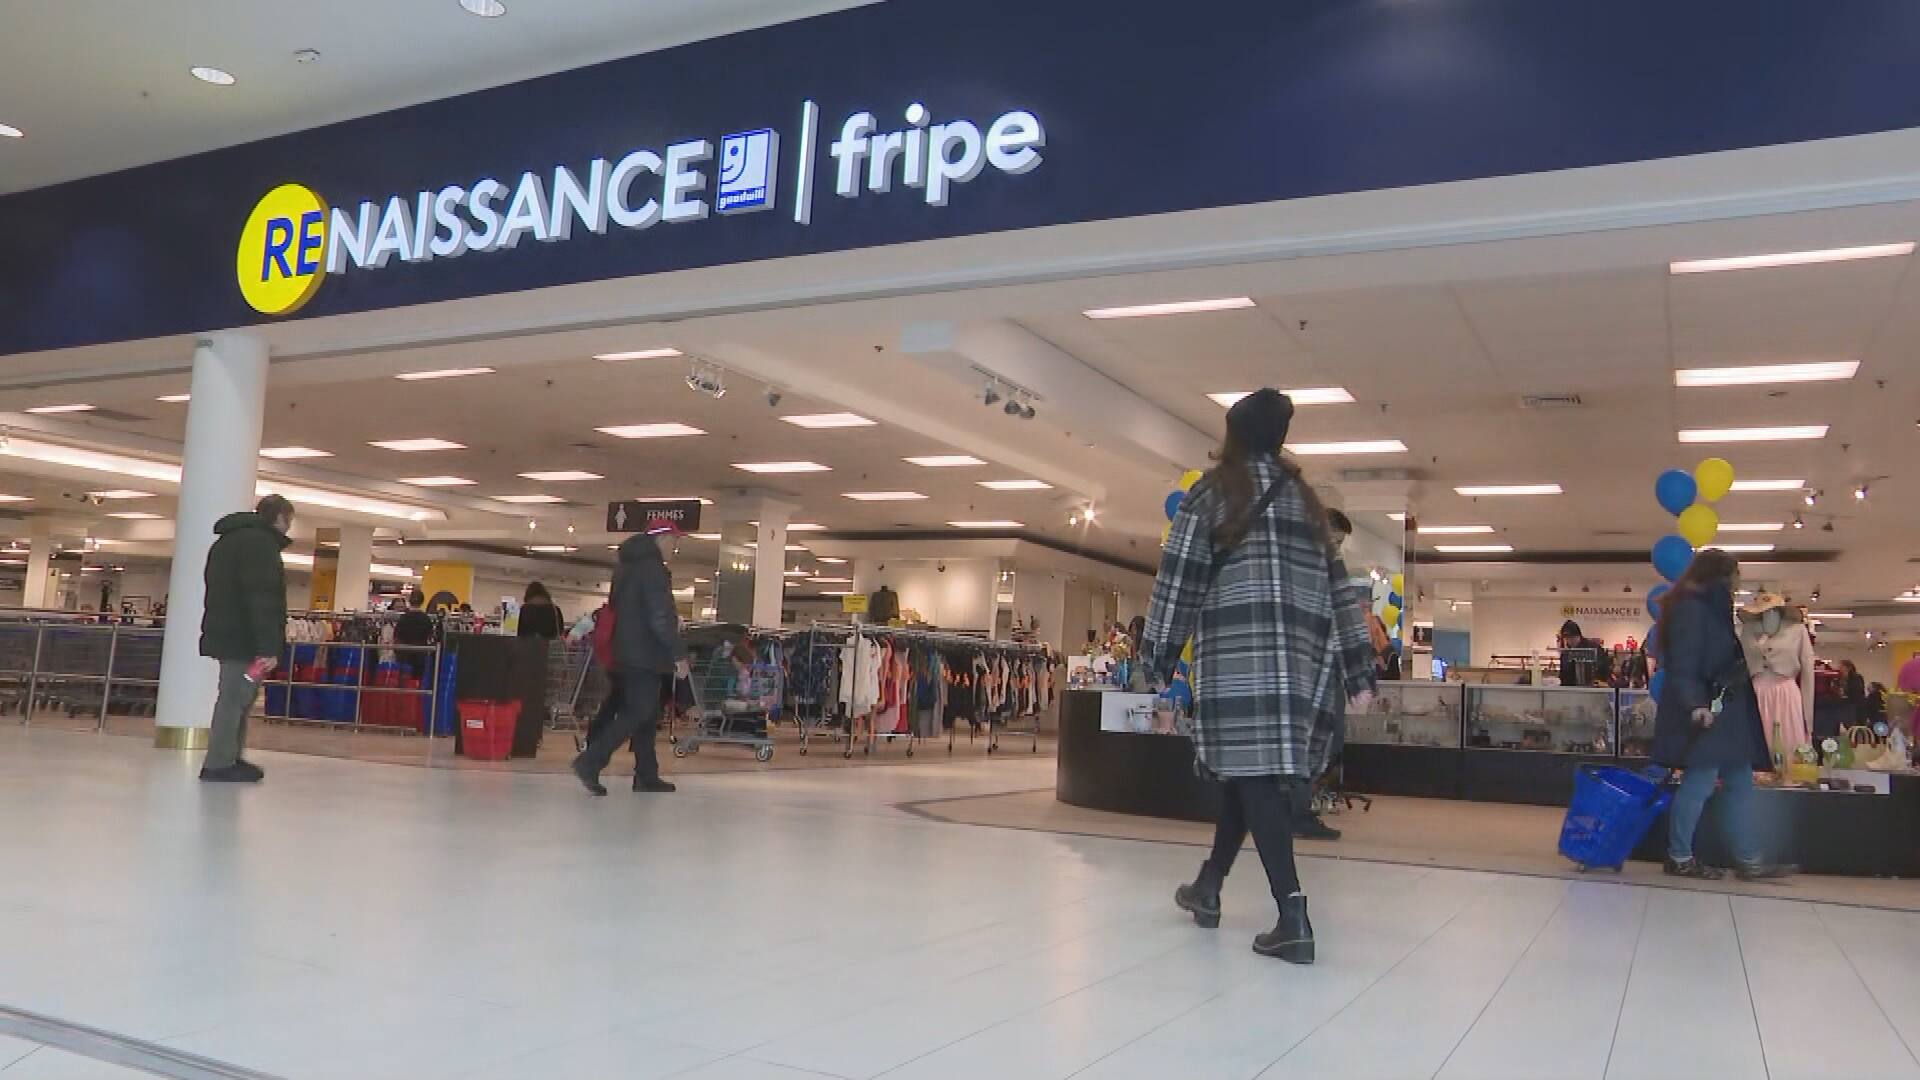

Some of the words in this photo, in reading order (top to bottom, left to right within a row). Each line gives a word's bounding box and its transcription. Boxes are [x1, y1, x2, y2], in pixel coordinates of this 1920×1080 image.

[261, 139, 712, 282] RENAISSANCE
[831, 103, 1044, 206] fripe
[719, 187, 765, 209] goodwill
[646, 509, 685, 520] FEMMES
